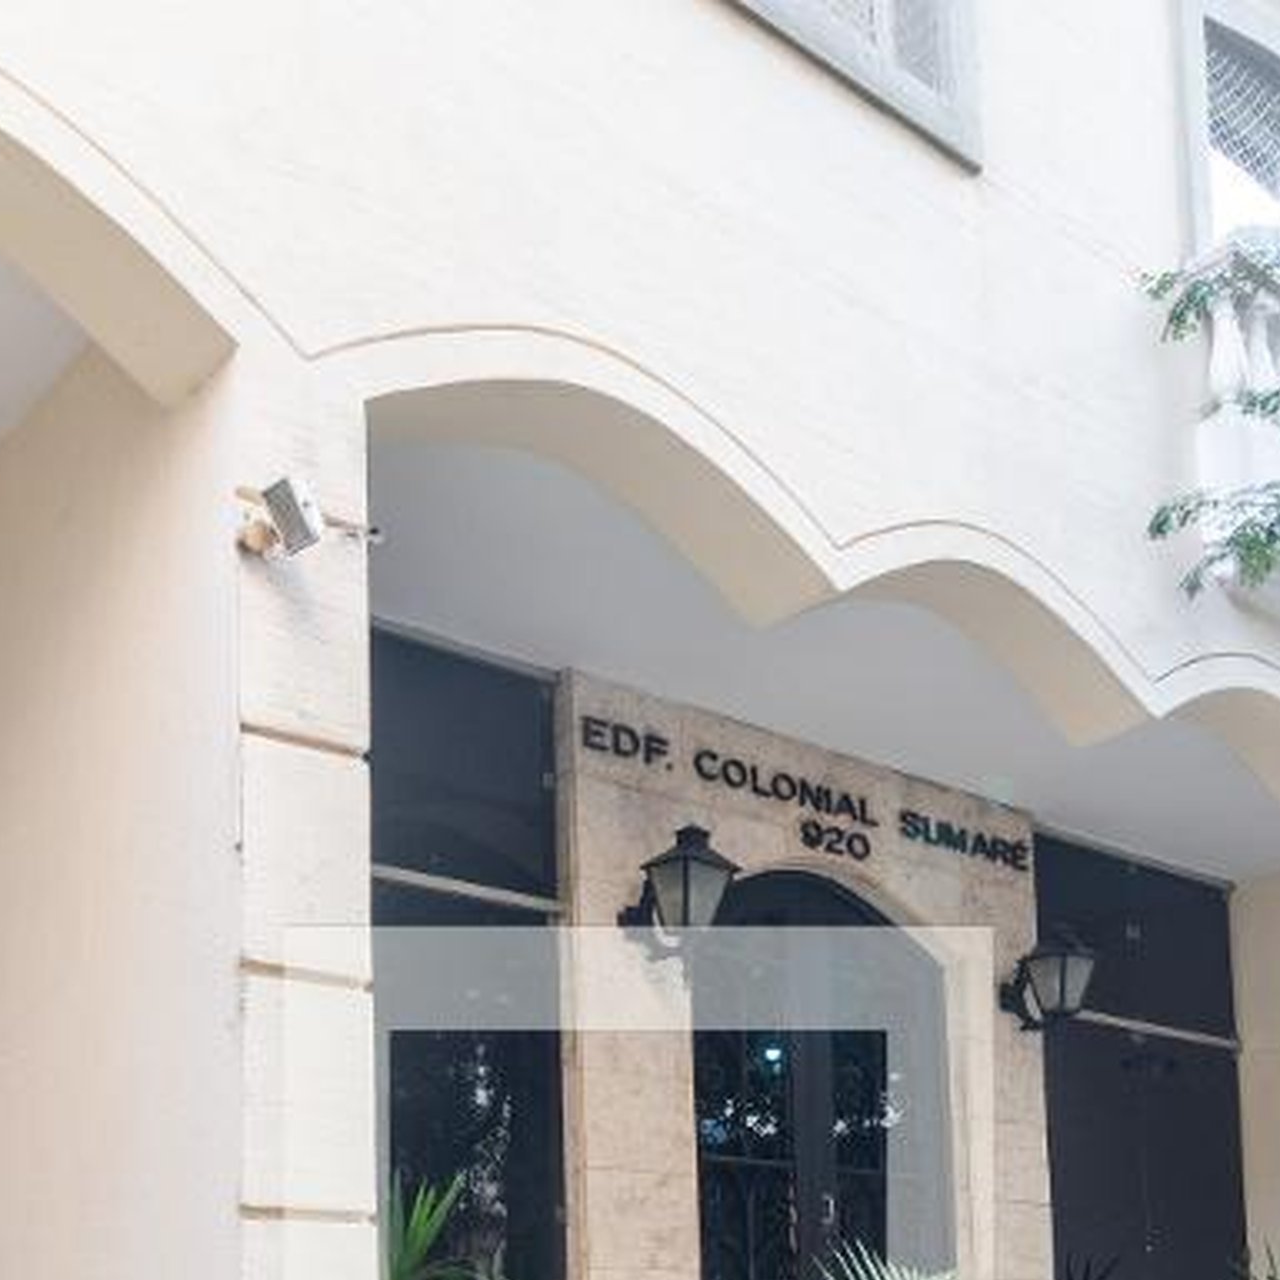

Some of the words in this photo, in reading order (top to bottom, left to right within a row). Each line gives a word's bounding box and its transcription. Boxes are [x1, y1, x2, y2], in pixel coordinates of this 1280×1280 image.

[581, 716, 673, 770] EDF.
[693, 750, 880, 826] COLONIAL
[799, 819, 871, 861] 920
